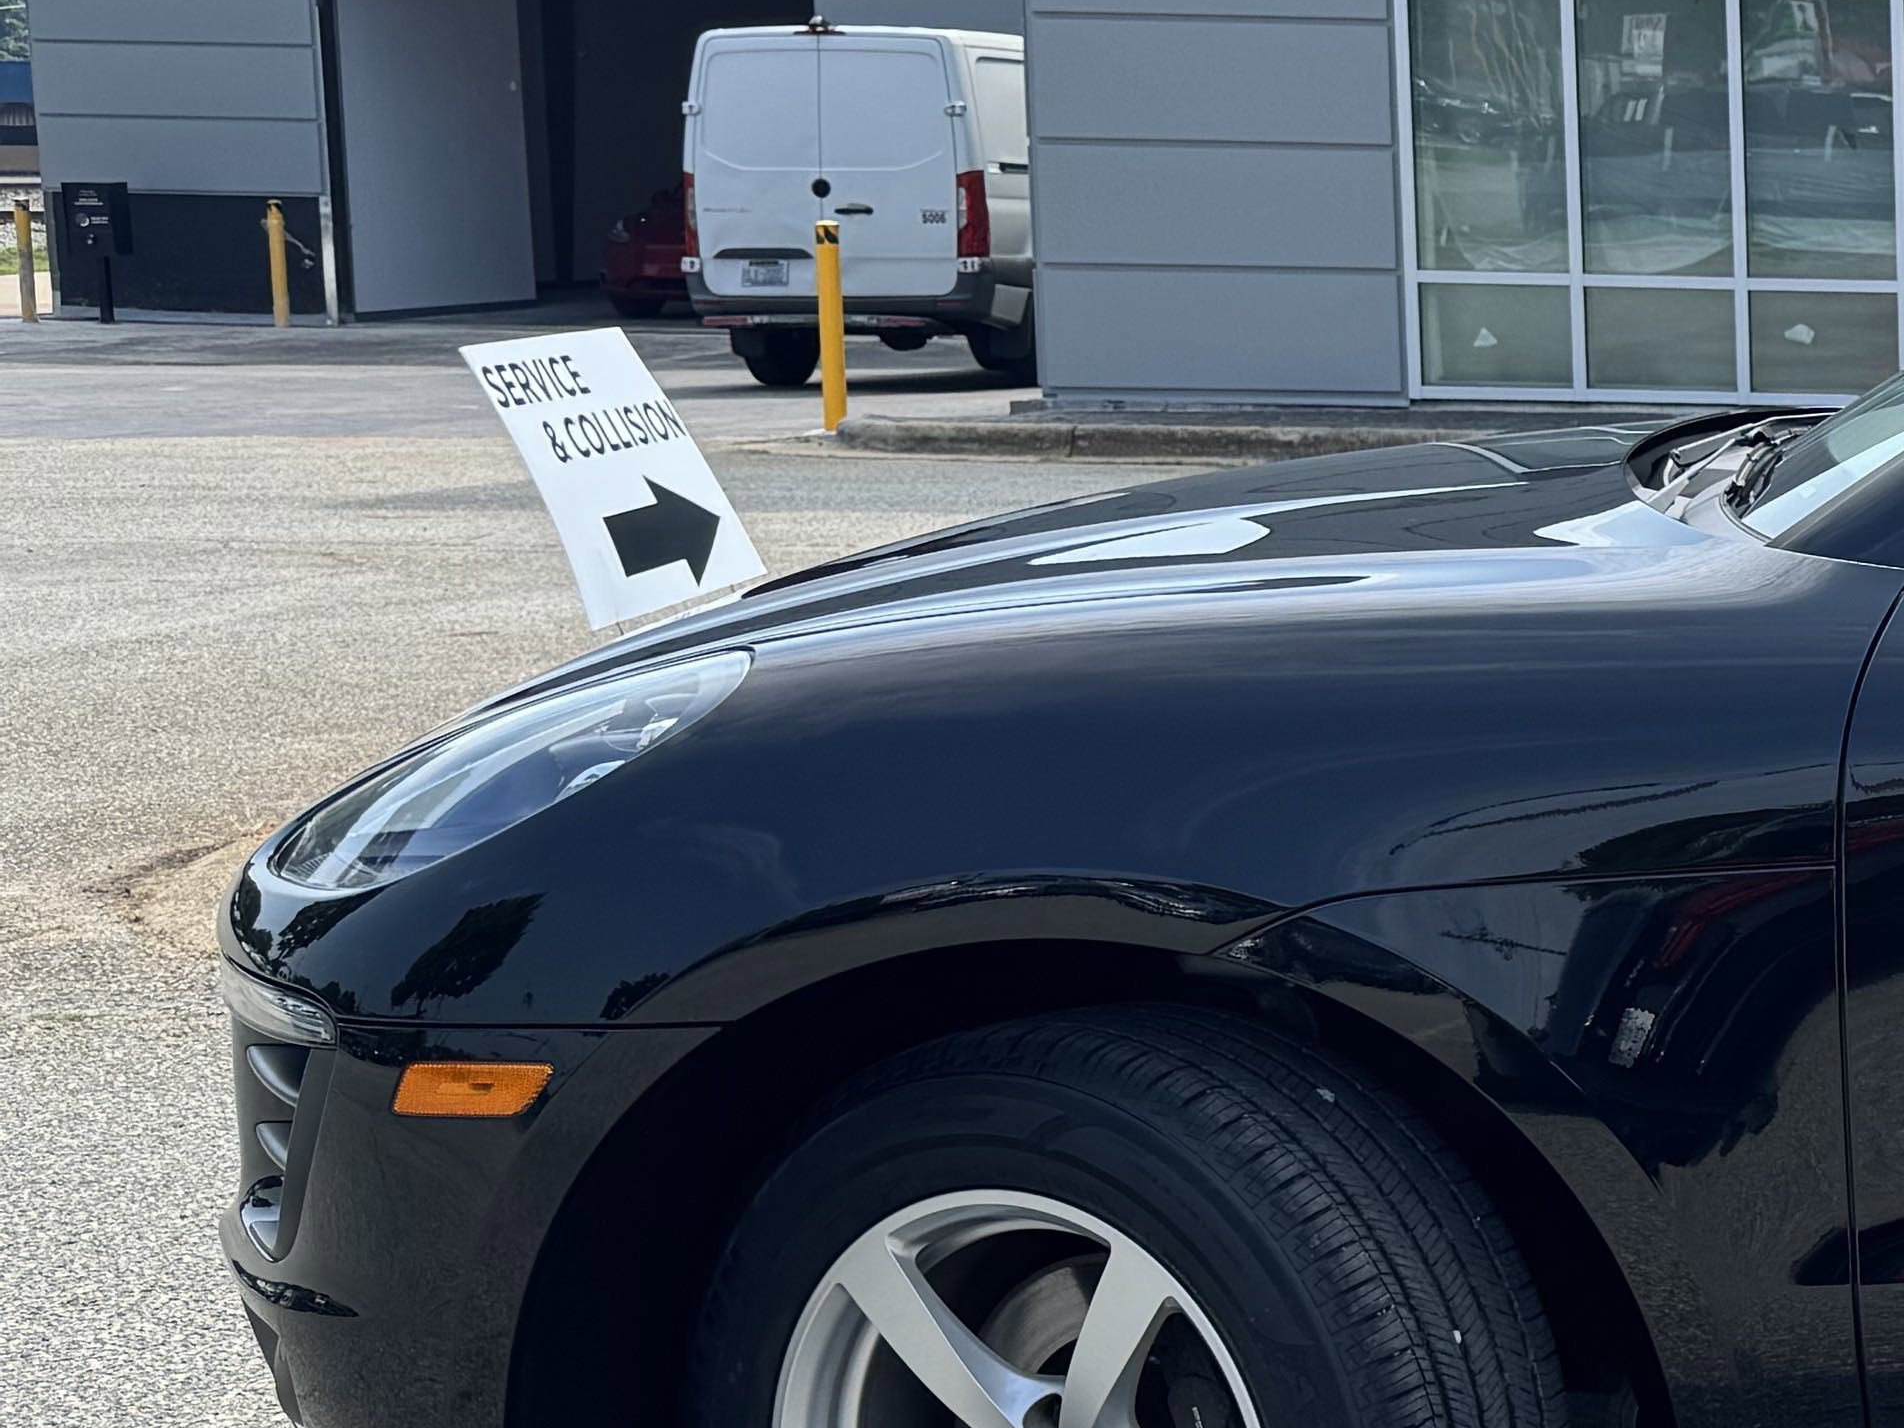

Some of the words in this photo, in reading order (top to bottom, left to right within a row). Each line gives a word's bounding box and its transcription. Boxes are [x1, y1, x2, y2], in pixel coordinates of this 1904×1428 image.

[481, 355, 591, 408] SERVICE
[542, 420, 573, 463] &
[563, 400, 687, 458] COLLISION
